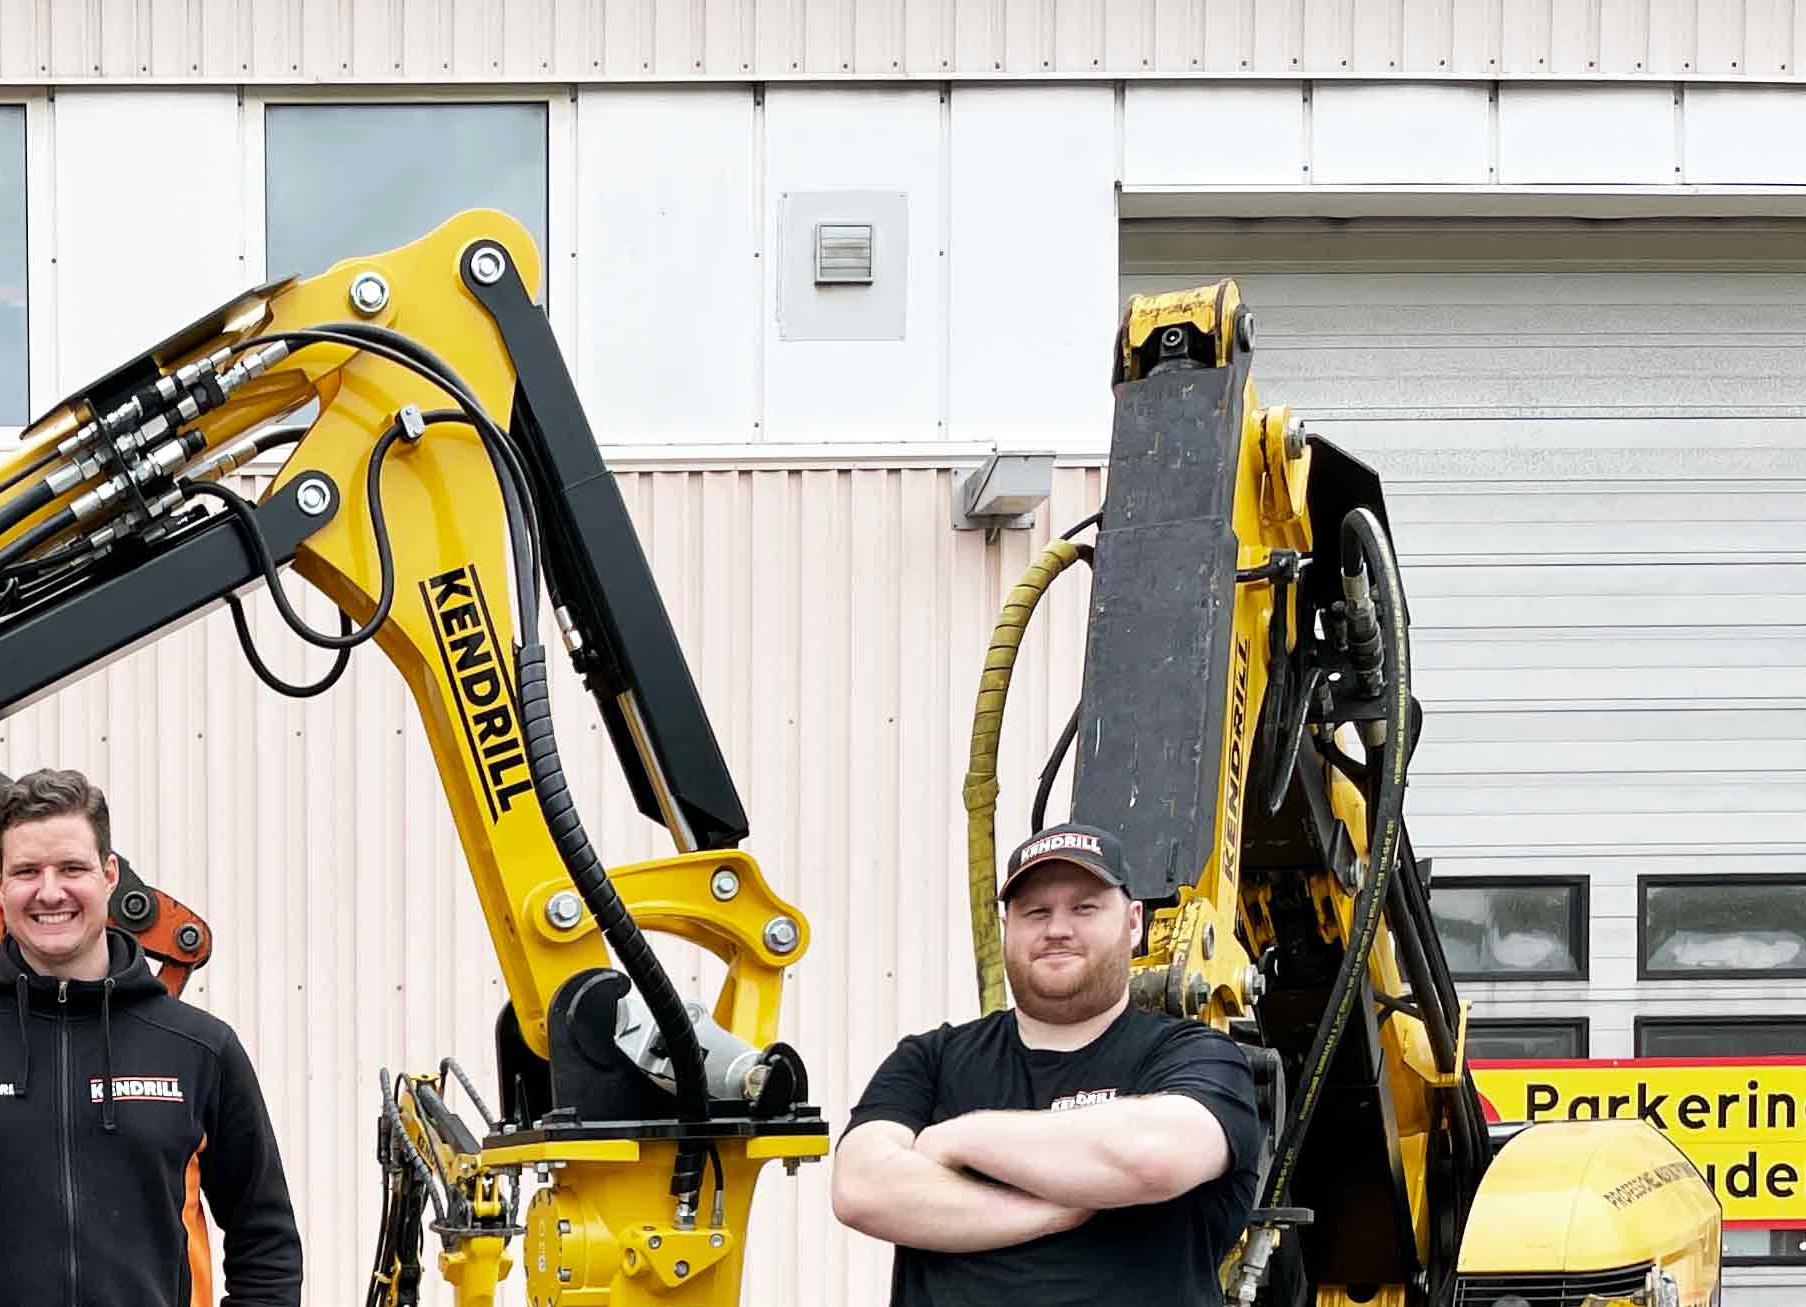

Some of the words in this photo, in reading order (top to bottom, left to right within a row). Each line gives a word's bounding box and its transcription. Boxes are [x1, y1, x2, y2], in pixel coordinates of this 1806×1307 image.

[429, 567, 533, 813] KENDRILL
[1222, 638, 1248, 883] KENDRILL
[1020, 836, 1103, 866] KENDRILL
[1526, 1079, 1806, 1130] Parkerin
